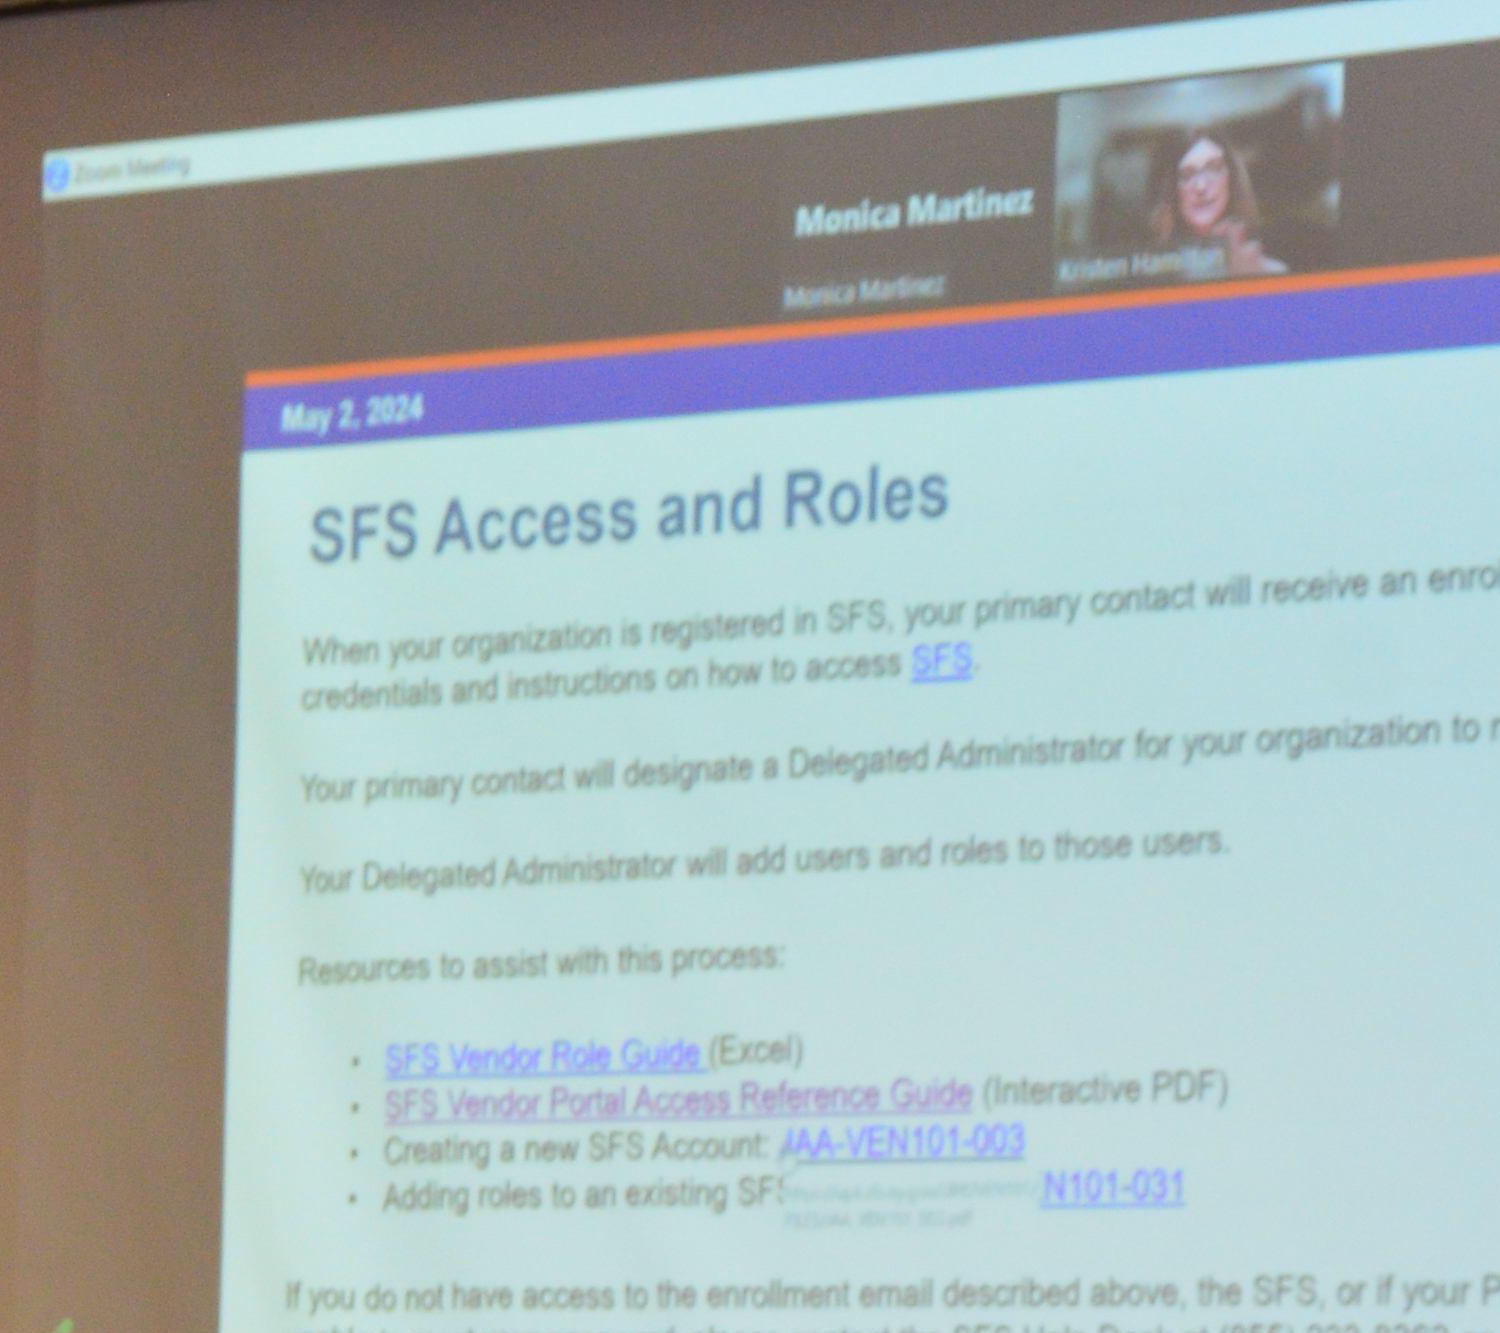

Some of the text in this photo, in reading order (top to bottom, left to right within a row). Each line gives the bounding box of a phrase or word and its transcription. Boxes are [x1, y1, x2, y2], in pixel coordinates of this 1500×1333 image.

[795, 186, 1034, 238] Monica Martinez
[783, 272, 946, 311] Monica Martinez
[281, 392, 424, 437] May 2, 2024
[311, 464, 950, 565] SFS Access and Roles
[302, 635, 379, 667] When
[389, 632, 443, 671] your
[451, 621, 611, 663] organization
[620, 619, 642, 648] is
[650, 606, 785, 650] registered
[793, 605, 818, 636] in
[904, 602, 965, 636] your
[974, 591, 1081, 631] primary
[1089, 581, 1196, 616] contact
[1204, 575, 1252, 608] will
[1261, 569, 1369, 606] receive
[1379, 568, 1418, 597] an
[302, 675, 442, 712] credentials
[451, 672, 499, 705] and
[507, 663, 656, 700] instructions
[665, 662, 698, 693] on
[708, 654, 763, 689] how
[771, 654, 797, 685] to
[806, 650, 901, 682] access
[302, 773, 356, 803] Your
[364, 770, 463, 806] primary
[471, 764, 566, 798] contact
[574, 758, 615, 791] will
[624, 752, 753, 792] designate
[763, 754, 778, 781] a
[789, 741, 929, 784] Delegated
[937, 730, 1125, 770] Administrator
[1134, 726, 1174, 761] for
[1182, 724, 1246, 766] your
[1256, 715, 1441, 761] organization
[1451, 712, 1480, 745] to
[302, 827, 1231, 896] Your Delegated Administrator will add users and roles to those users.
[300, 951, 431, 987] Resources
[440, 949, 465, 980] to
[473, 948, 548, 980] assist
[557, 943, 608, 977] with
[618, 942, 663, 974] this
[385, 1033, 802, 1077] SFS Vendor Role Guide (Excel)
[385, 1068, 1230, 1123] SFS Vendor Portal Access Reference Guide (Interactive PDF)
[384, 1136, 490, 1171] Creating
[499, 1140, 515, 1164] a
[524, 1138, 579, 1164] new
[588, 1133, 644, 1163] SFS
[383, 1182, 470, 1217] Adding
[478, 1180, 543, 1210] roles
[552, 1178, 577, 1209] to
[585, 1181, 617, 1209] an
[626, 1178, 728, 1215] existing
[285, 1281, 303, 1310] If
[309, 1286, 356, 1315] you
[364, 1284, 397, 1312] do
[404, 1282, 445, 1311] not
[453, 1281, 514, 1310] have
[522, 1285, 615, 1310] access
[625, 1282, 649, 1310] to
[657, 1280, 698, 1309] the
[706, 1279, 850, 1310] enrollment
[859, 1277, 934, 1309] email
[942, 1276, 1082, 1308] described
[1198, 1275, 1243, 1307] the
[1337, 1279, 1367, 1306] or
[1377, 1274, 1395, 1306] if
[1404, 1279, 1468, 1313] your
